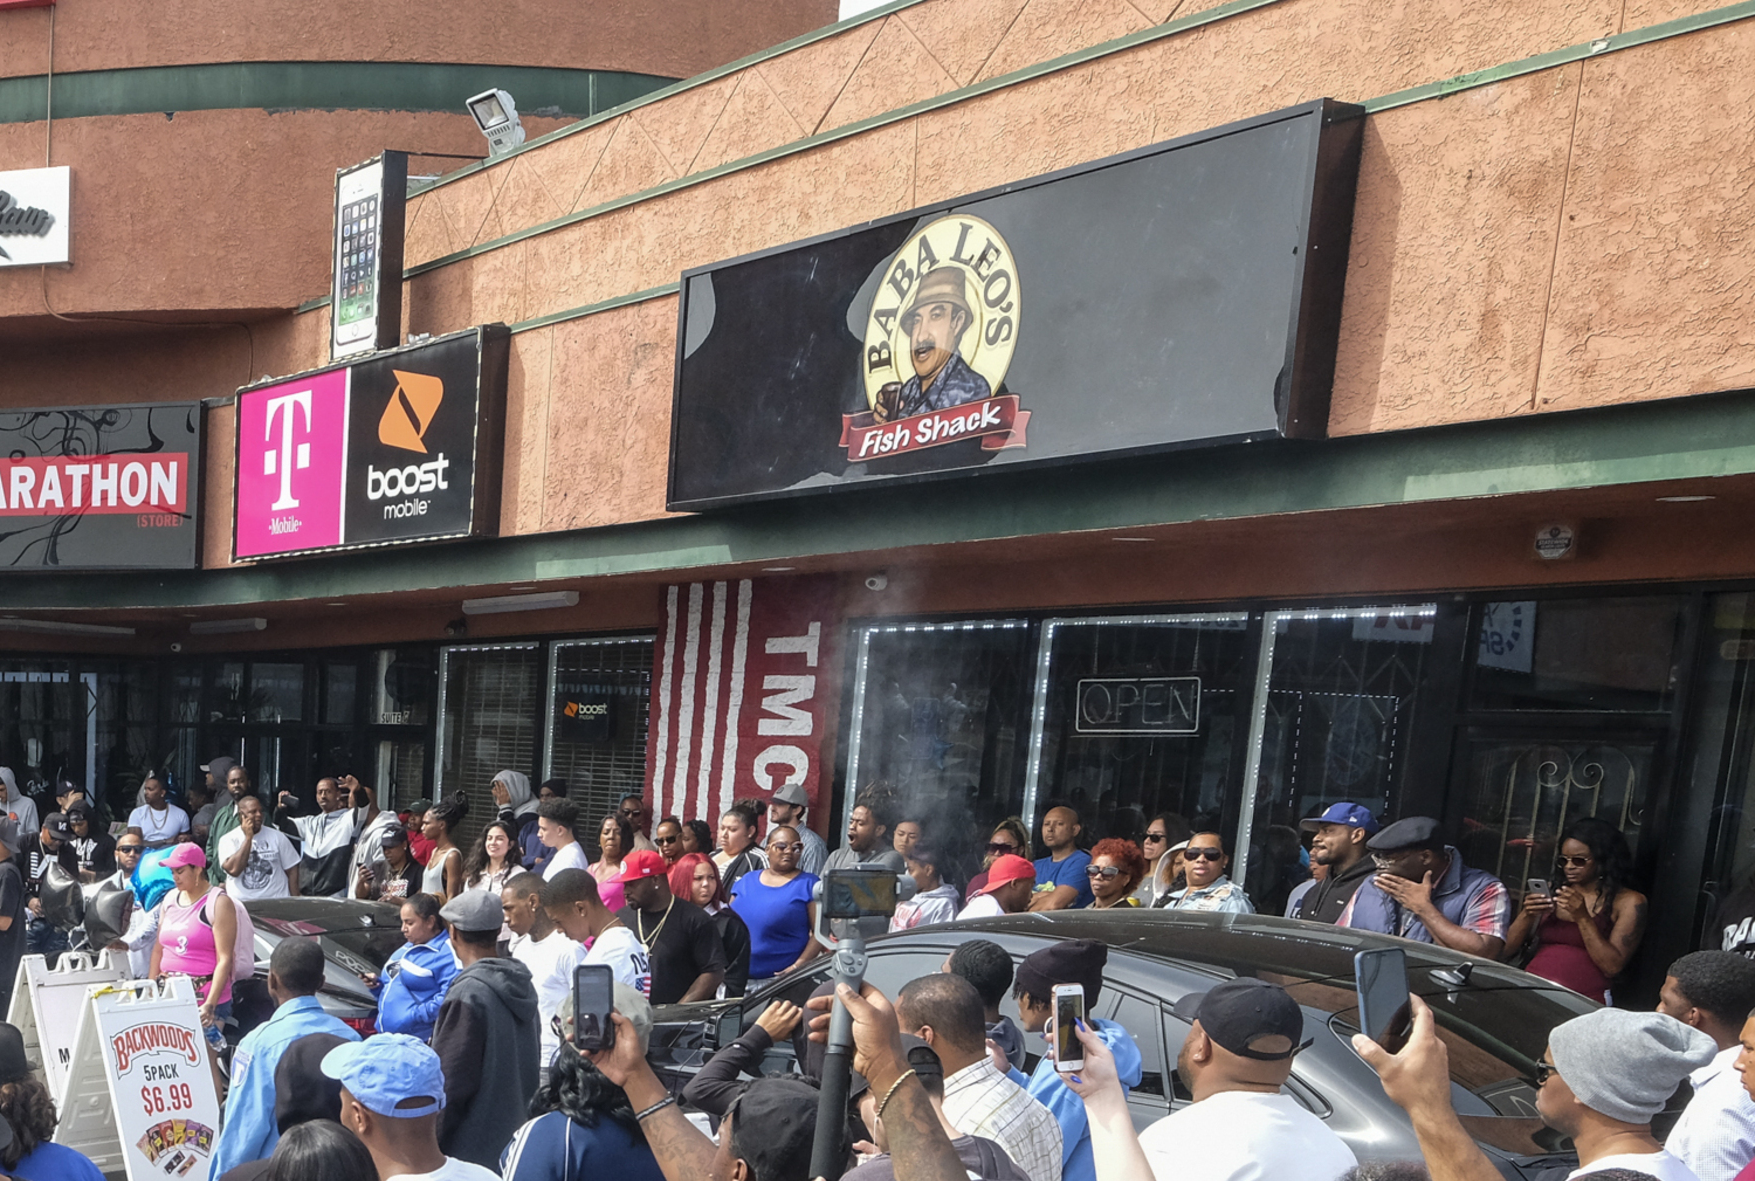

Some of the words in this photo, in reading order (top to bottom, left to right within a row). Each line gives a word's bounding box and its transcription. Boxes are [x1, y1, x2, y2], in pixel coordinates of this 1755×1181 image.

[867, 234, 940, 374] BABA
[858, 428, 911, 457] Fish
[915, 402, 1001, 443] Shack
[367, 452, 449, 500] boost
[136, 514, 184, 527] (STORE)
[384, 499, 428, 519] mobile
[381, 713, 402, 724] SUITE
[579, 703, 607, 714] boost
[753, 621, 821, 790] TMC
[1082, 684, 1195, 724] OPEN
[175, 935, 188, 953] 3
[114, 1025, 197, 1071] BACKWOODS
[143, 1063, 179, 1082] 5PACK
[141, 1082, 193, 1116] $6.99
